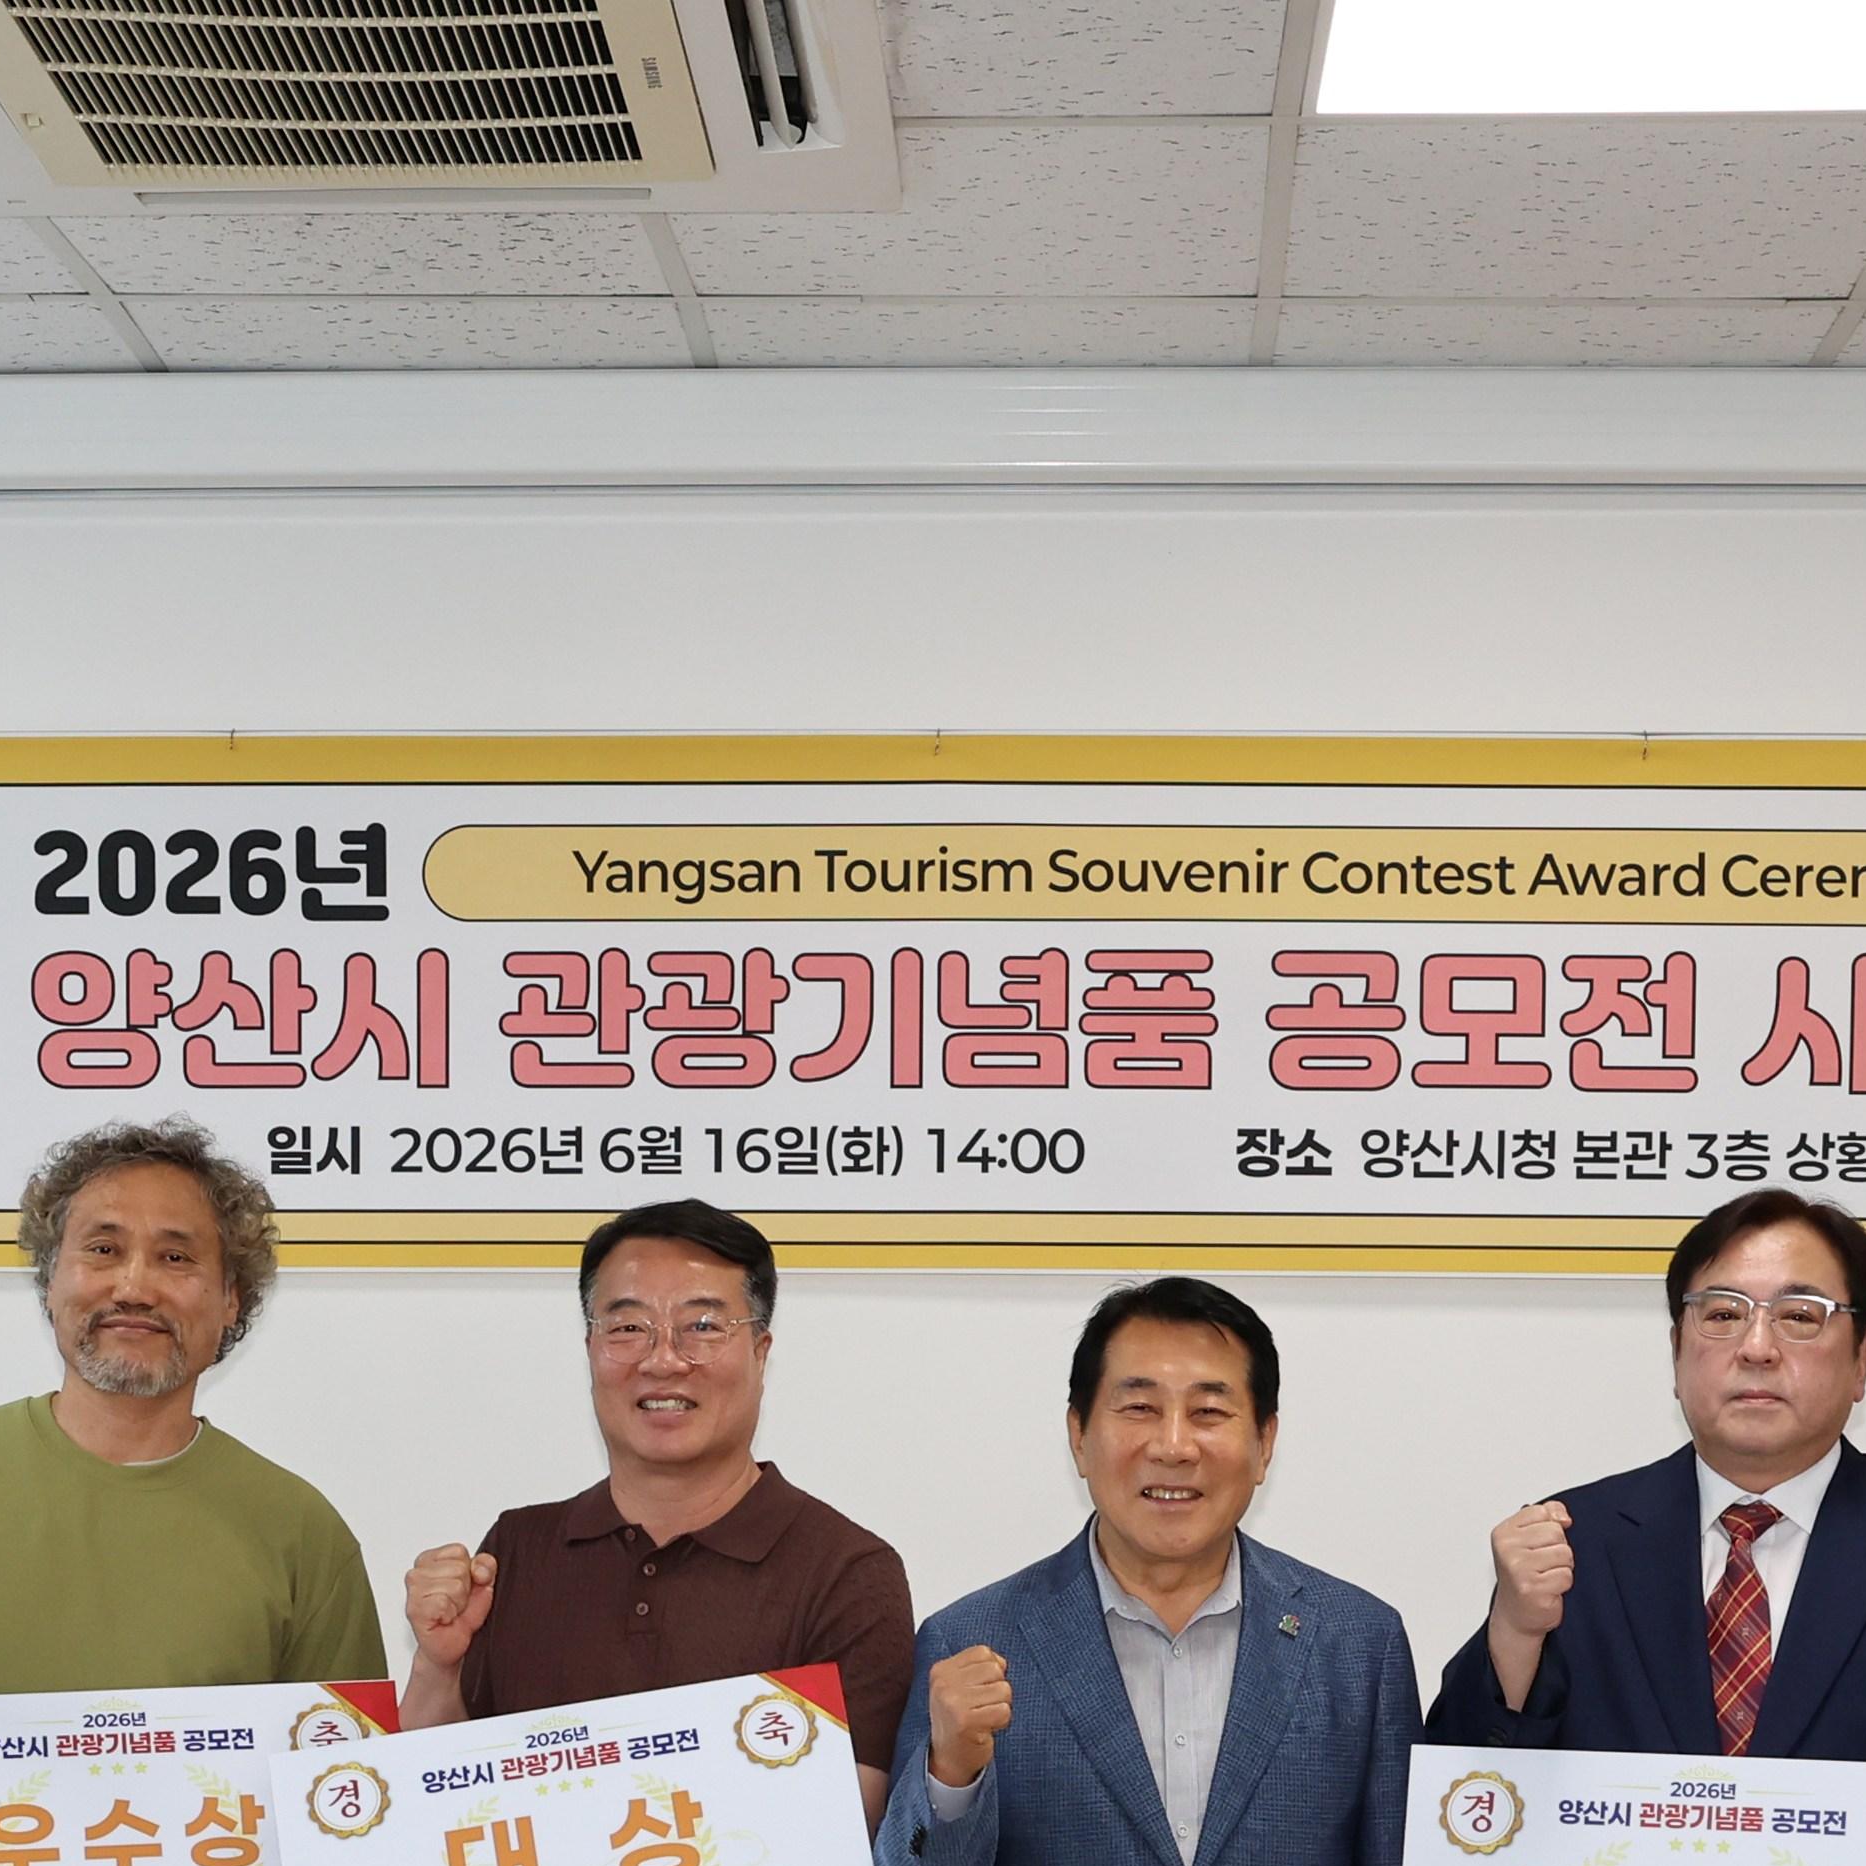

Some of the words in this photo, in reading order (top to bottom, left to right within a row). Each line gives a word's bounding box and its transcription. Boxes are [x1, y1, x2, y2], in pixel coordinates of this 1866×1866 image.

[34, 823, 390, 921] 2026년
[572, 850, 800, 904] Yangsan
[814, 846, 1032, 892] Tourism
[1048, 848, 1289, 893] Souvenir
[1303, 852, 1516, 895] Contest
[1528, 852, 1705, 896] Award
[31, 948, 449, 1089] 양산시
[499, 947, 1218, 1089] 관광기념품
[1266, 950, 1698, 1093] 공모전
[267, 1126, 360, 1175] 일시
[390, 1126, 583, 1174] 2026년
[600, 1126, 682, 1174] 6월
[705, 1125, 903, 1176] 16일(화)
[927, 1128, 1085, 1174] 14:00
[1236, 1128, 1332, 1178] 장소
[1361, 1129, 1556, 1179] 양산시청
[1573, 1131, 1672, 1180] 본관
[1685, 1130, 1770, 1181] 3층
[83, 1712, 146, 1728] 2026년
[525, 1726, 589, 1748] 2026년
[755, 1712, 794, 1746] 축
[56, 1731, 175, 1757] 관광기념품
[183, 1728, 254, 1752] 공모전
[422, 1762, 494, 1793] 양산시
[501, 1743, 621, 1781] 관광기념품
[628, 1728, 700, 1760] 공모전
[329, 1780, 361, 1818] 경
[1671, 1782, 1736, 1800] 2026년
[1462, 1791, 1495, 1832] 경
[1559, 1800, 1631, 1826] 양산시
[1640, 1803, 1764, 1832] 관광기념품
[1772, 1808, 1846, 1836] 공모전
